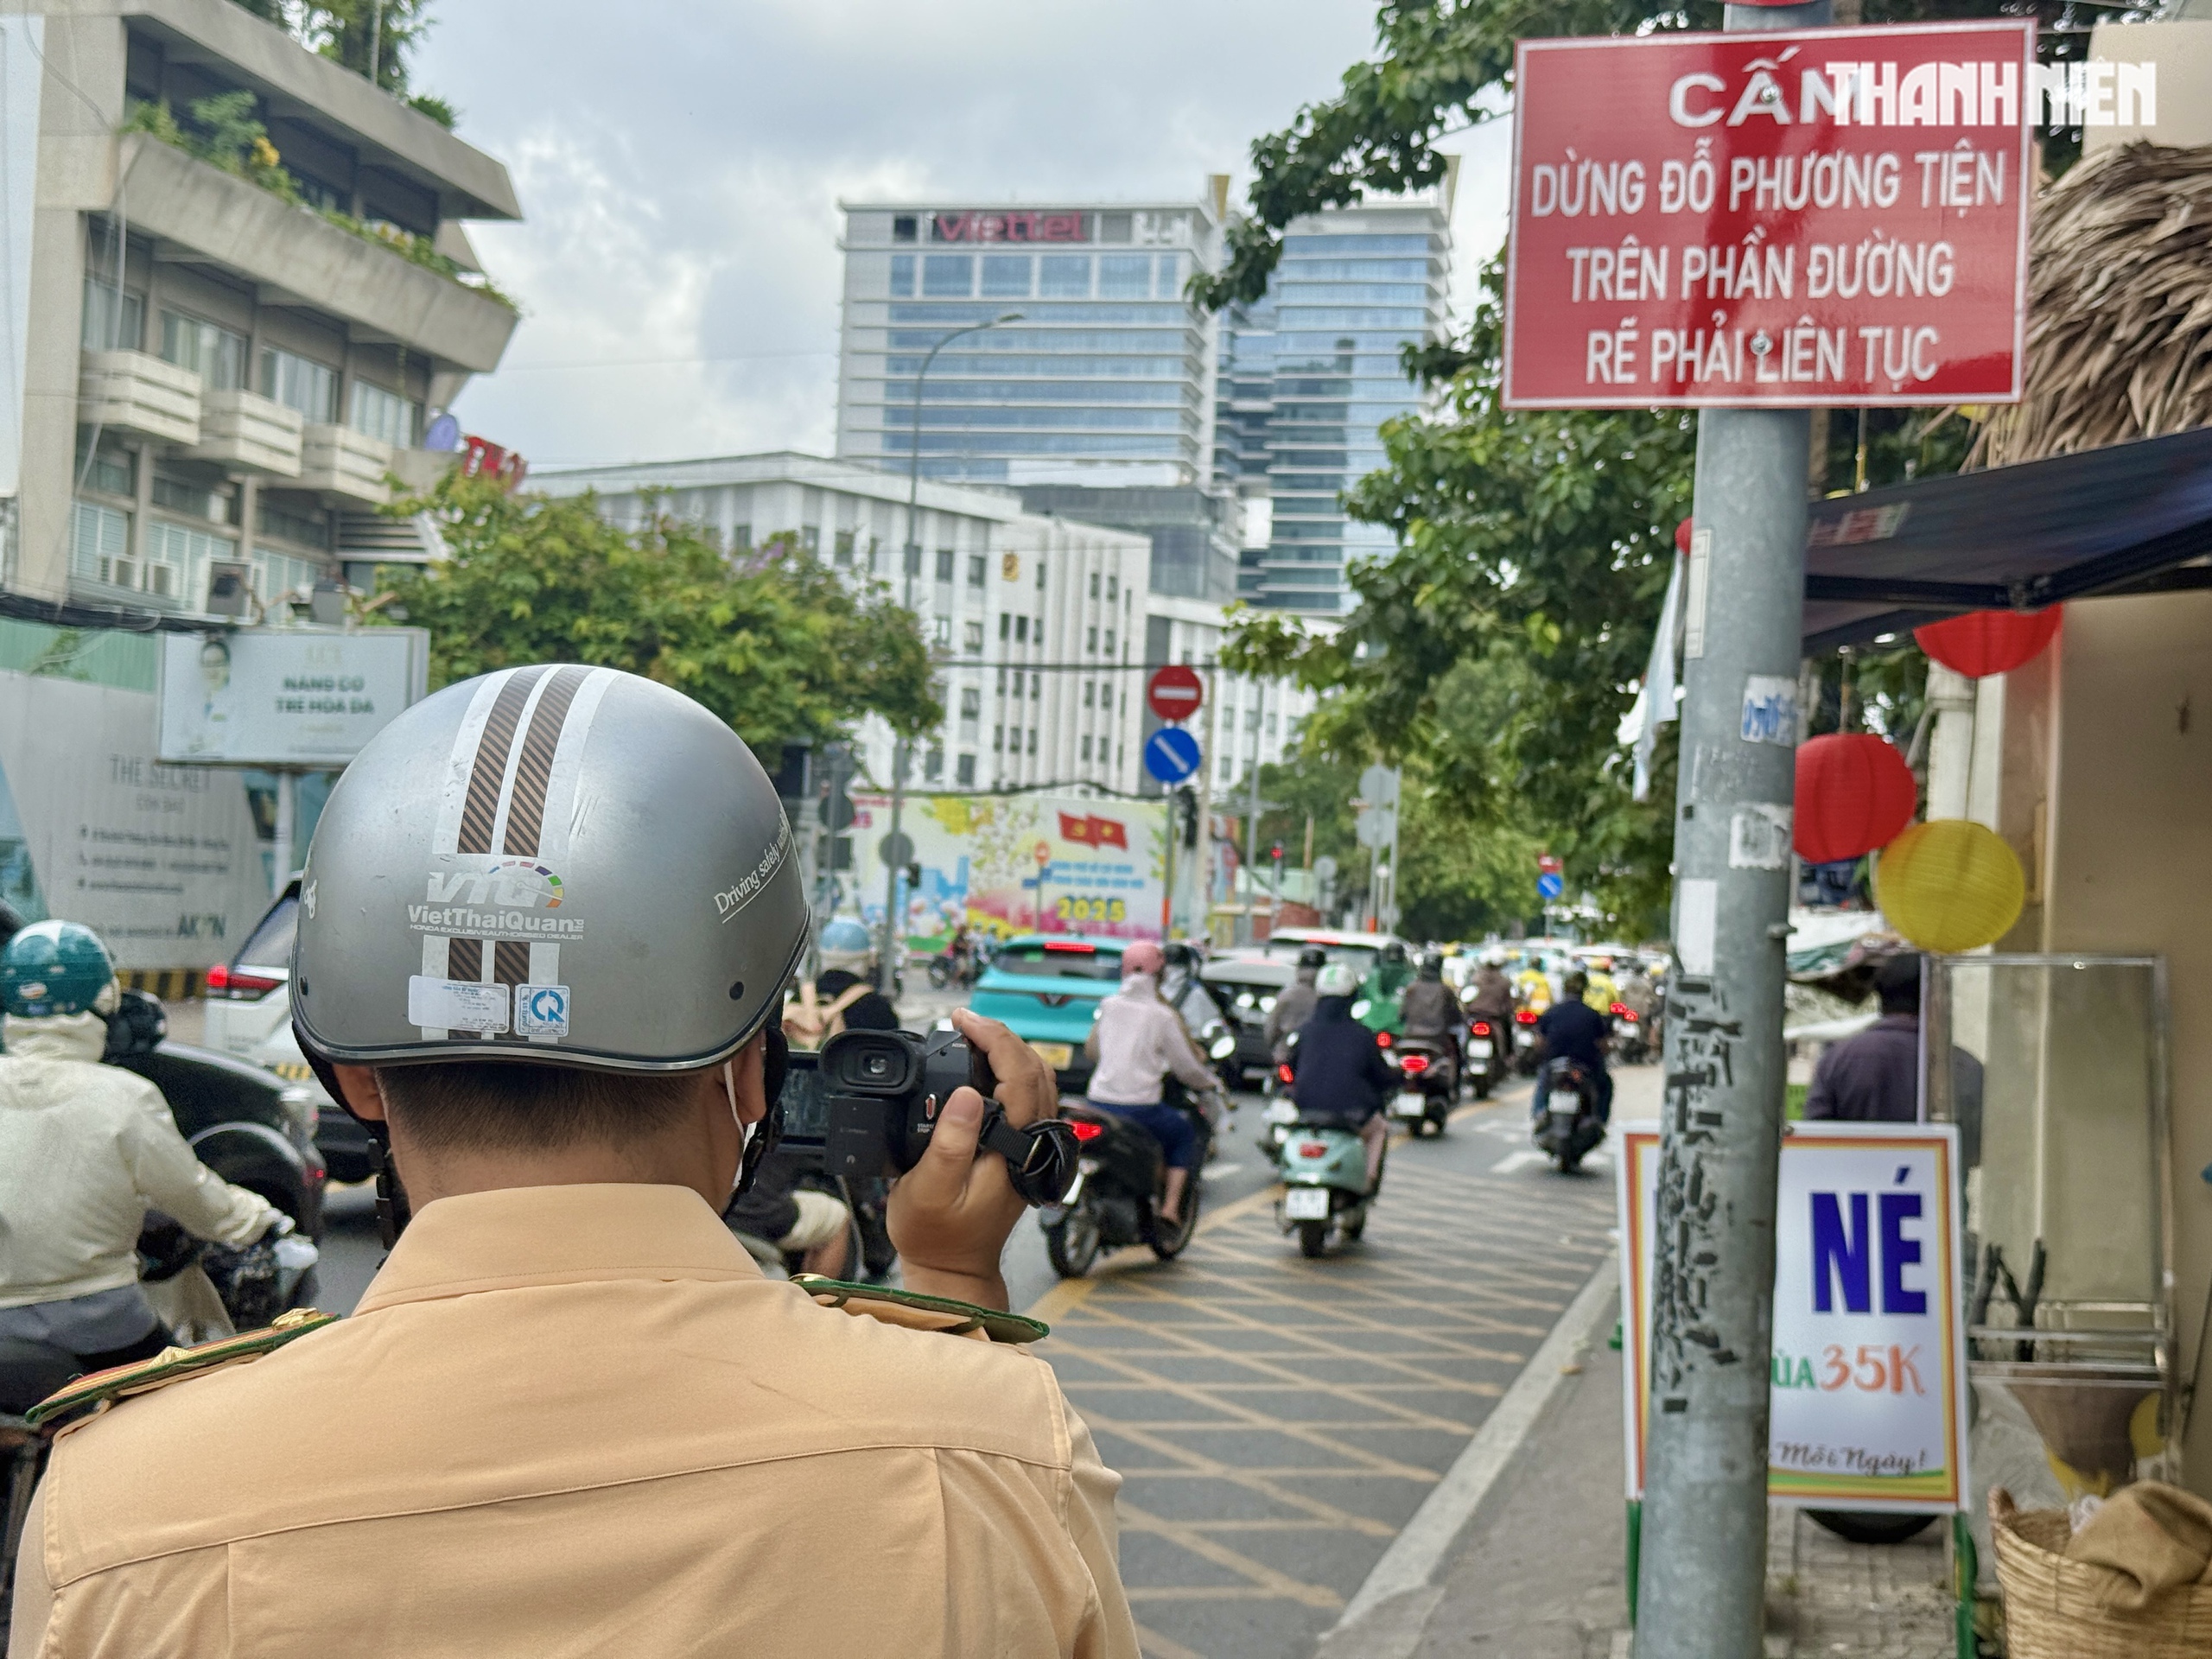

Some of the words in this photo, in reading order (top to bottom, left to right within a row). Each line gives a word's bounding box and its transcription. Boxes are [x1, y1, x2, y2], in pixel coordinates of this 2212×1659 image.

[1531, 145, 1646, 217] DỪNG
[1659, 137, 1716, 213] ĐỖ
[1729, 149, 1900, 212] PHƯƠNG
[1914, 137, 2007, 218] TIỆN
[1566, 233, 1669, 302] TRÊN
[1681, 224, 1795, 300] PHẦN
[1807, 227, 1955, 299] ĐƯỜNG
[1586, 315, 1640, 384] RẼ
[1650, 308, 1745, 384] PHẢI
[1754, 314, 1847, 384] LIÊN
[1859, 325, 1941, 392] TỤC
[714, 869, 760, 915] Driving
[759, 842, 780, 877] safely
[1057, 894, 1127, 923] 2025
[407, 905, 574, 932] VietThaiQuan
[1809, 1166, 1927, 1315] NÉ
[1820, 1343, 1926, 1395] 35K
